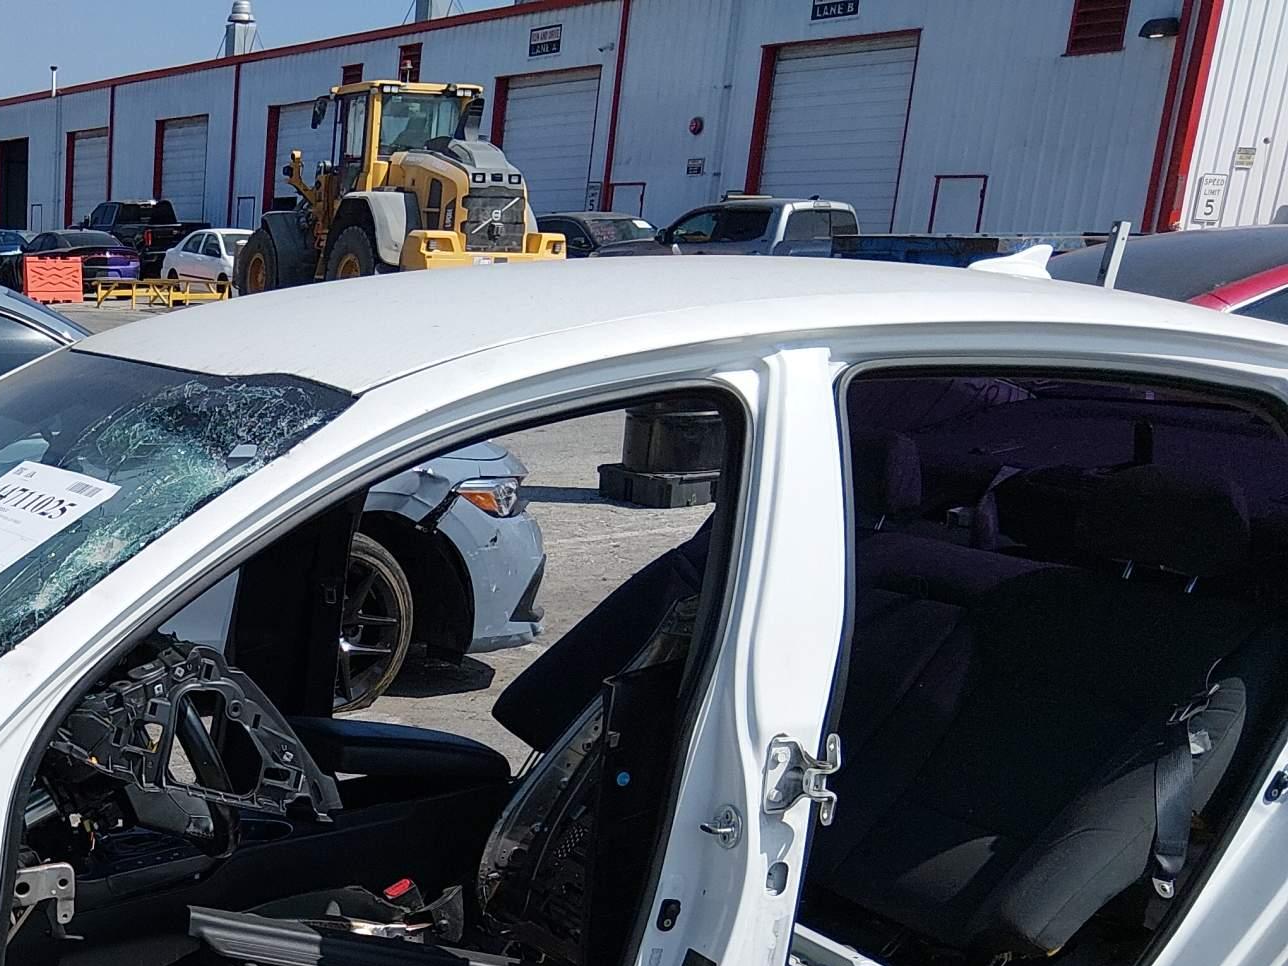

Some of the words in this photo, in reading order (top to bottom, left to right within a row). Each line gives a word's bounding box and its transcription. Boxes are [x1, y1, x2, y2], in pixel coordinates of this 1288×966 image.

[816, 5, 843, 17] LANE
[847, 3, 854, 12] B
[1204, 178, 1225, 186] SPEED
[1203, 199, 1215, 216] 5
